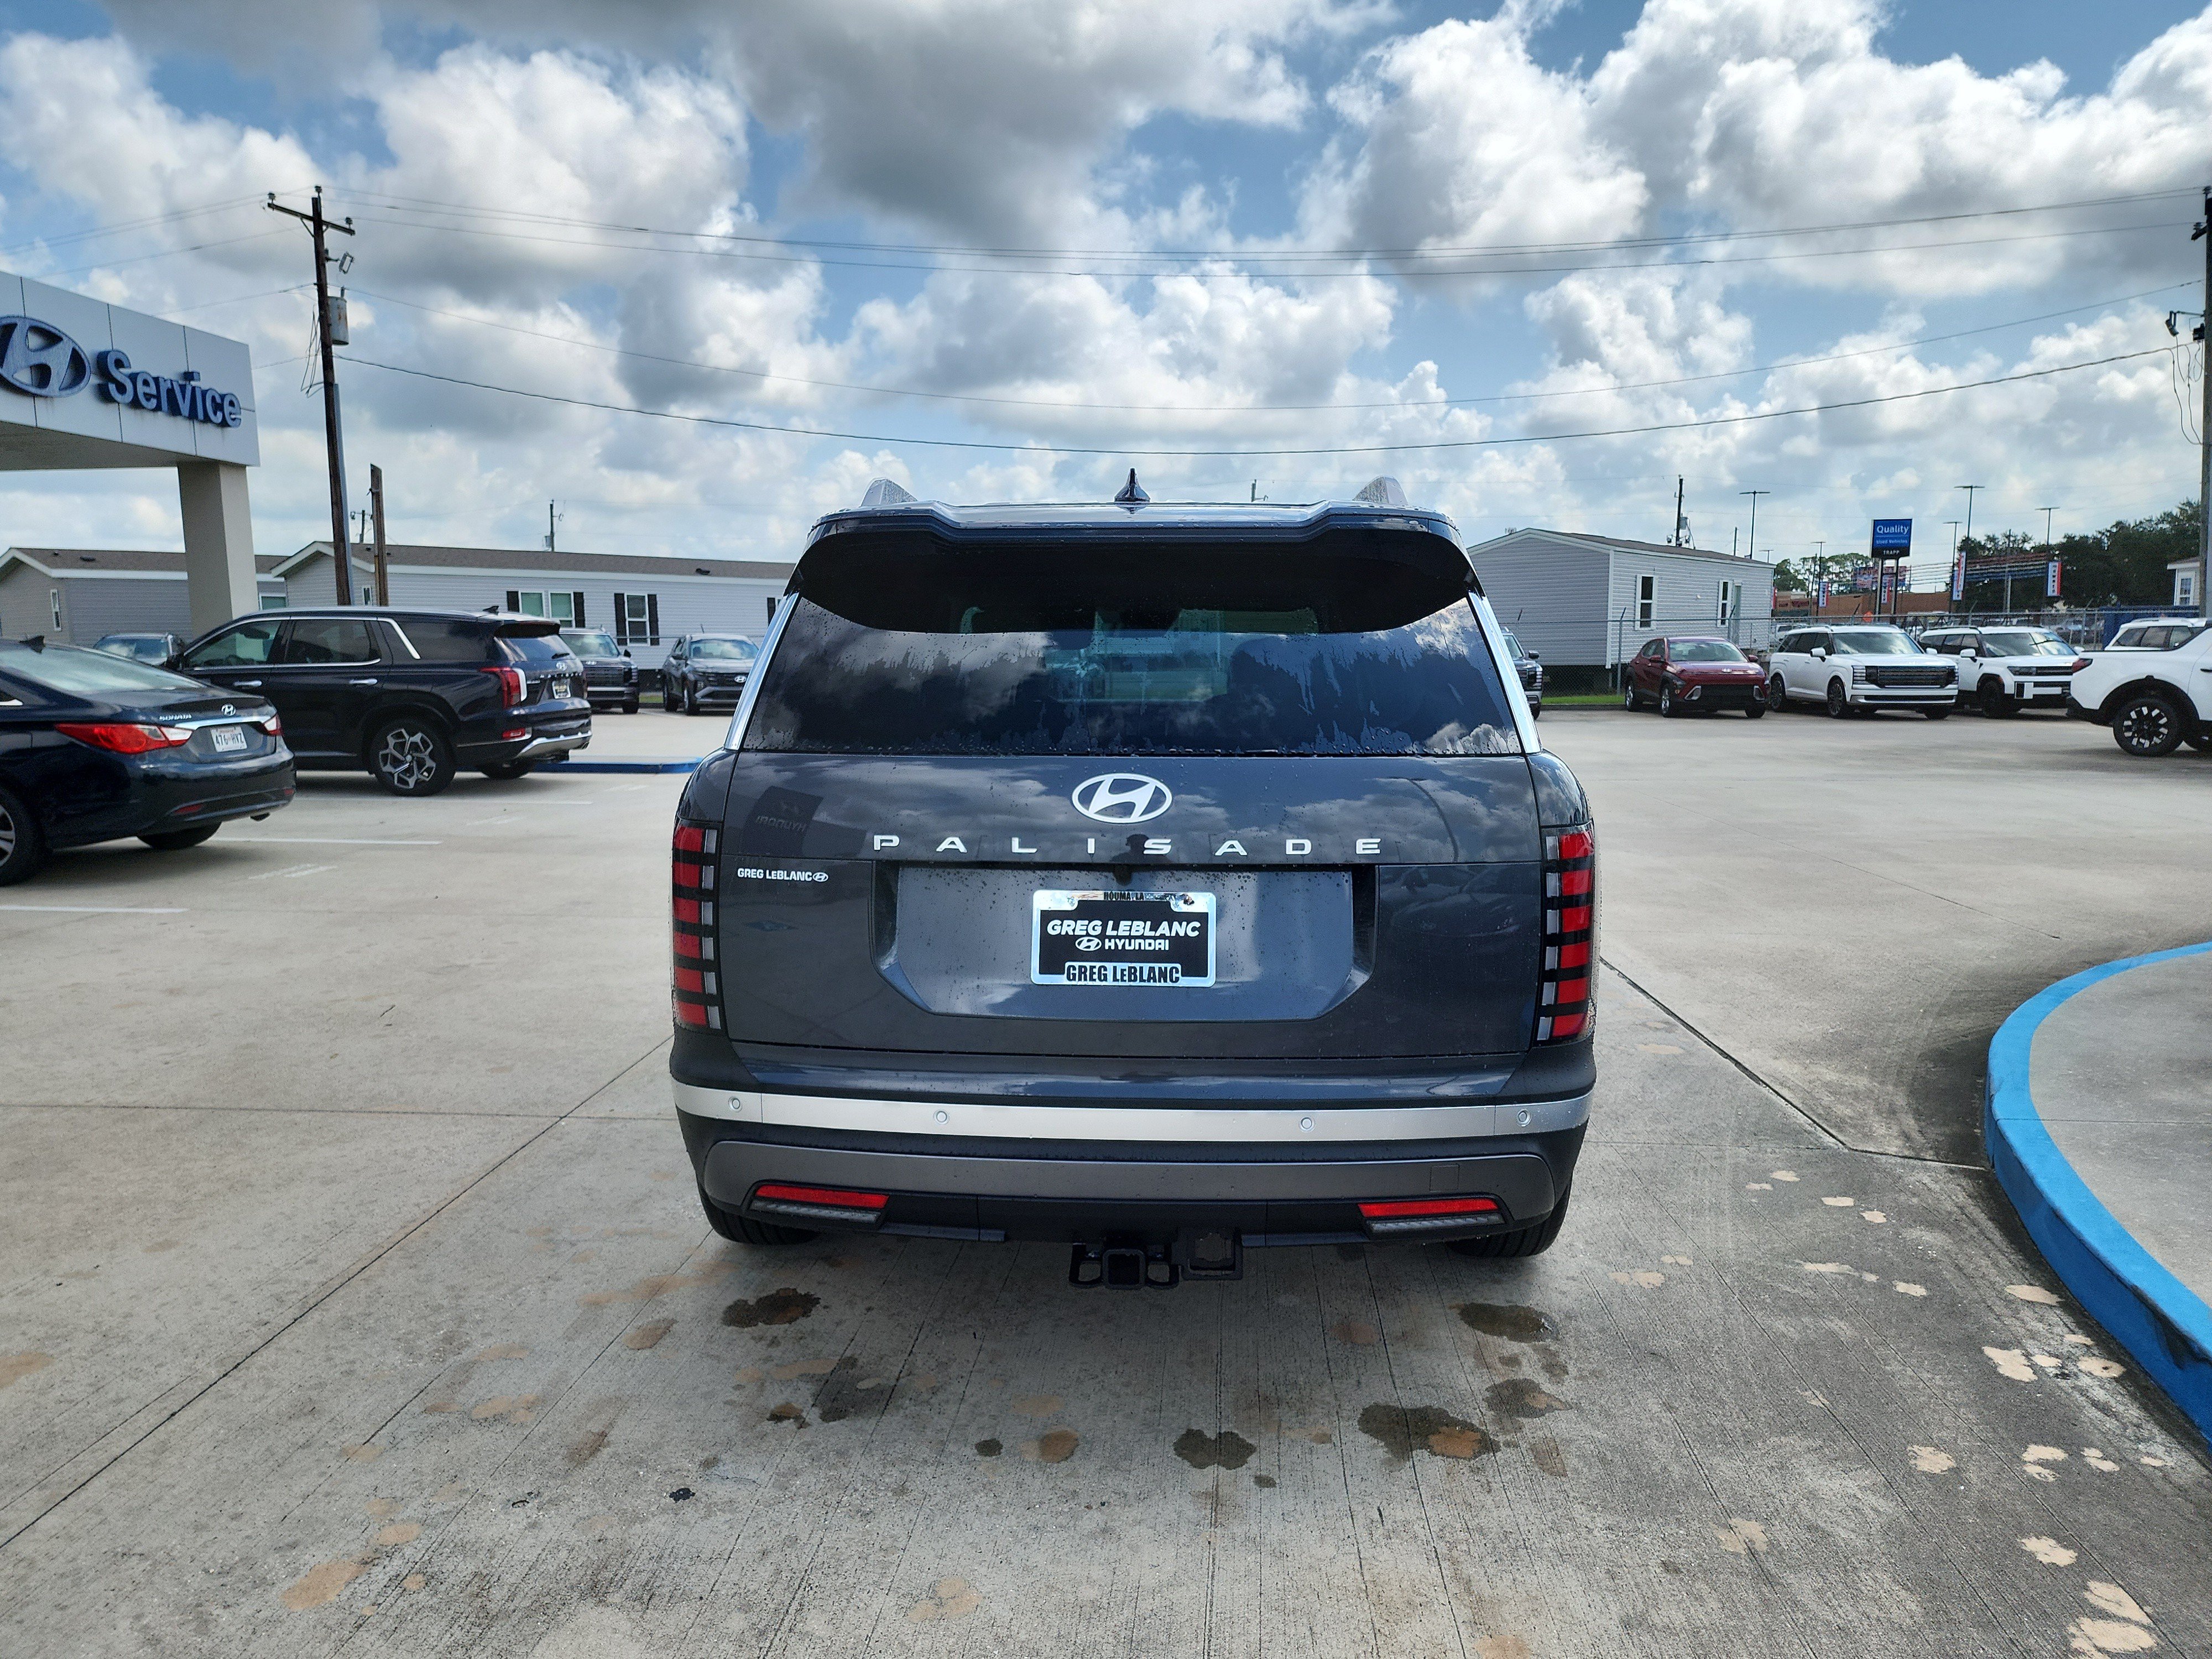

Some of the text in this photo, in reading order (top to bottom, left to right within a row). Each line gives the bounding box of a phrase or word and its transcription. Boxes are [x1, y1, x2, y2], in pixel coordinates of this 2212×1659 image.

[97, 350, 242, 427] Service
[1876, 525, 1910, 535] Quality
[873, 834, 1381, 856] PALISADE
[737, 868, 764, 879] GREG
[1135, 892, 1144, 901] LA
[1047, 920, 1201, 937] GREG LEBLANC
[1105, 938, 1169, 951] HYUNDAI
[1066, 964, 1108, 982] GREG
